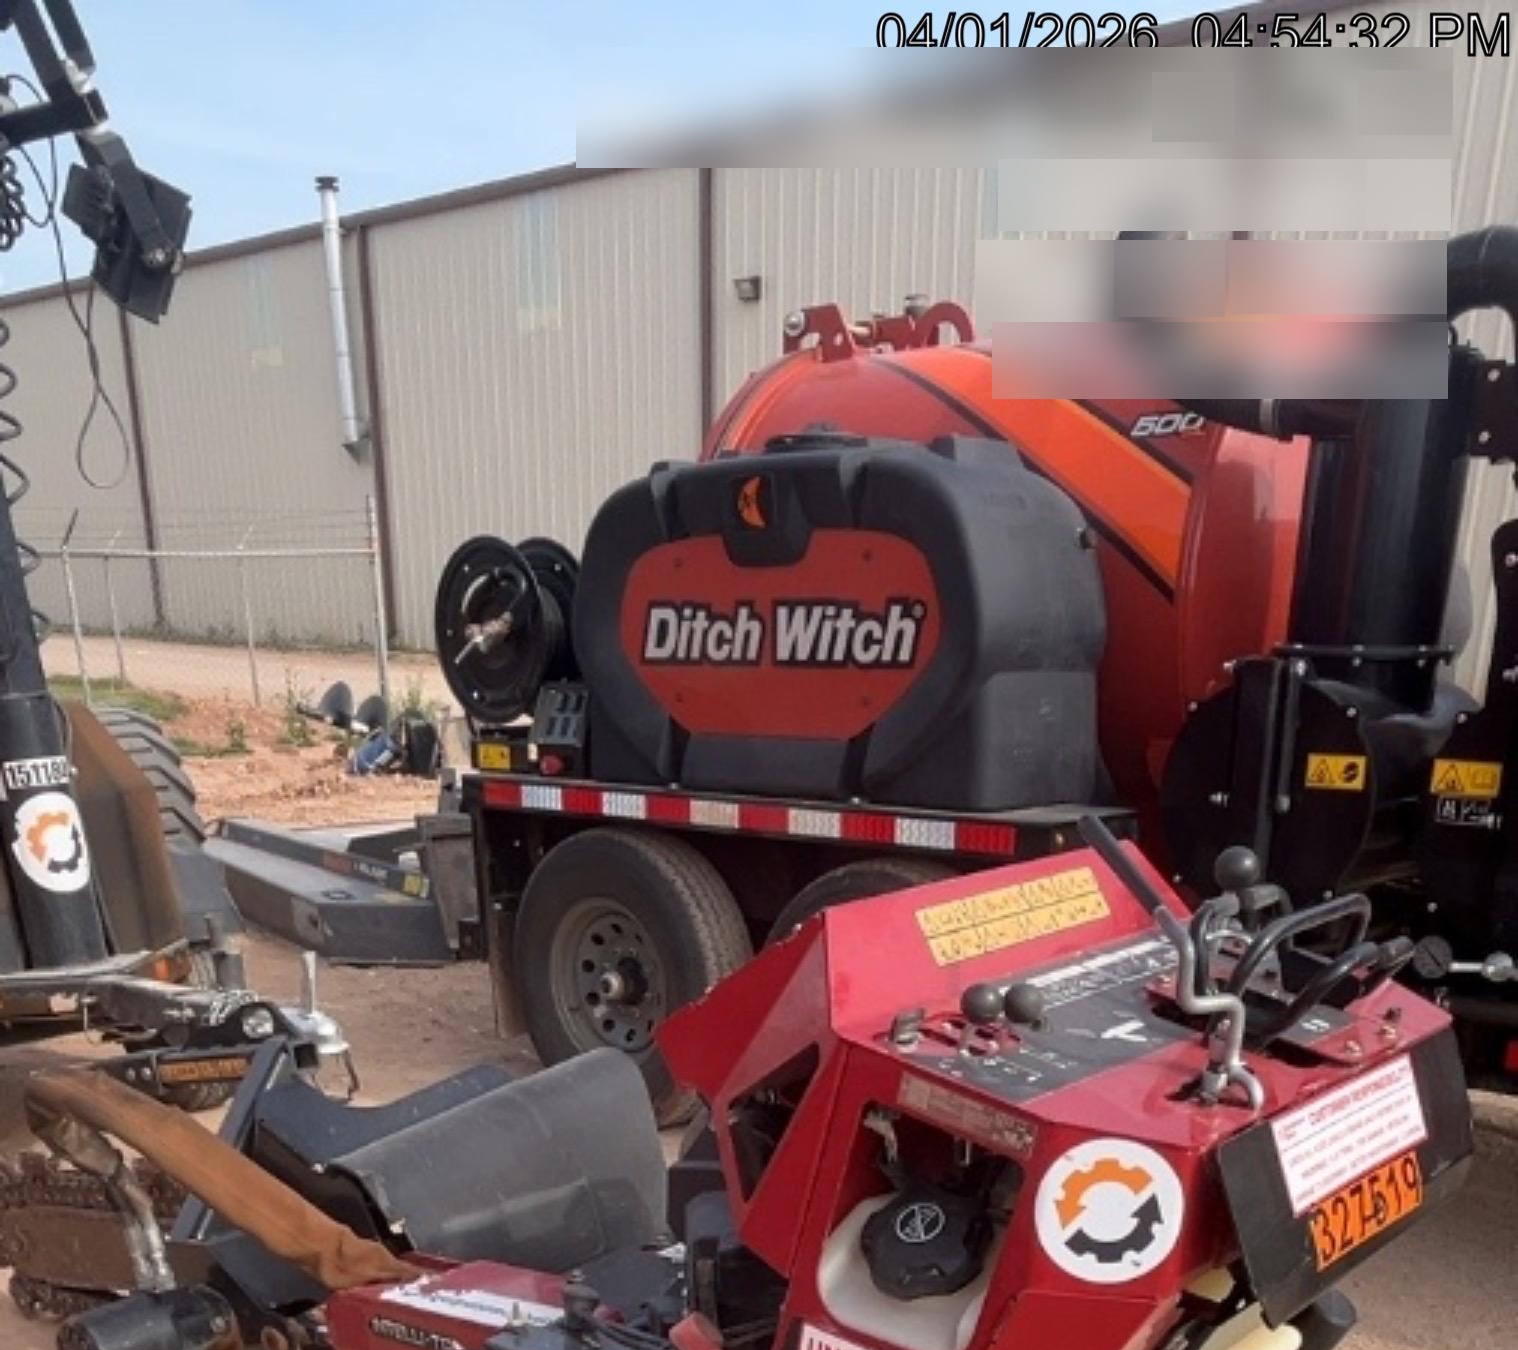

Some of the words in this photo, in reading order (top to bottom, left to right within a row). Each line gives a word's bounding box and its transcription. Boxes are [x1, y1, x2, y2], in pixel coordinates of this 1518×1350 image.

[644, 604, 763, 662] Ditch
[774, 603, 918, 664] Witch
[1313, 1157, 1417, 1262] 327519
